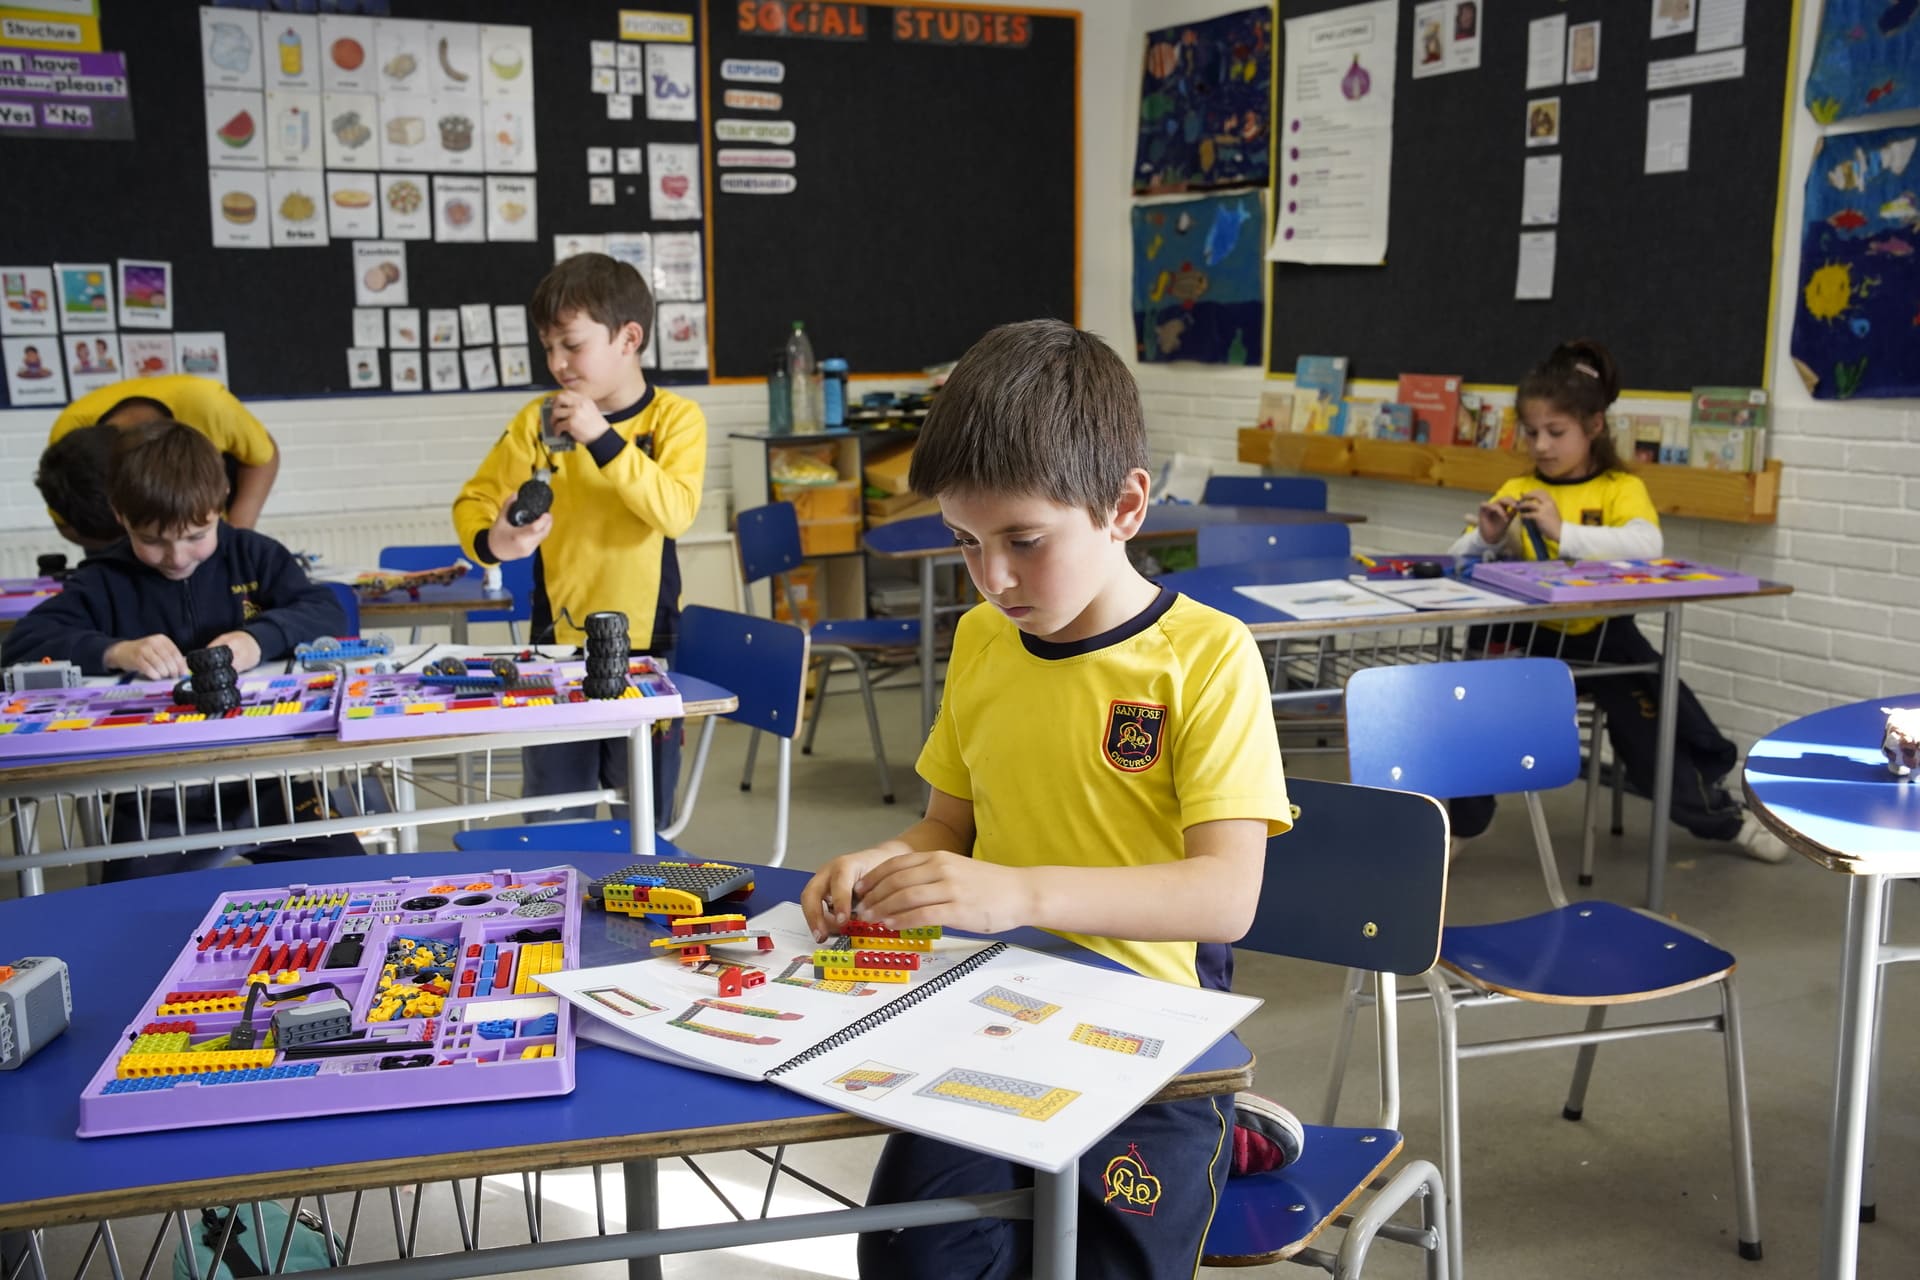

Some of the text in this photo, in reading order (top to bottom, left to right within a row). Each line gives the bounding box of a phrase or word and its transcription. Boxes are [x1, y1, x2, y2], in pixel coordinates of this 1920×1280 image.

[6, 21, 77, 39] Structure
[31, 55, 79, 71] have
[55, 75, 122, 93] please?
[0, 107, 88, 125] Yes No
[1115, 706, 1161, 720] SAN JOSE
[1111, 751, 1152, 767] CHICUREO
